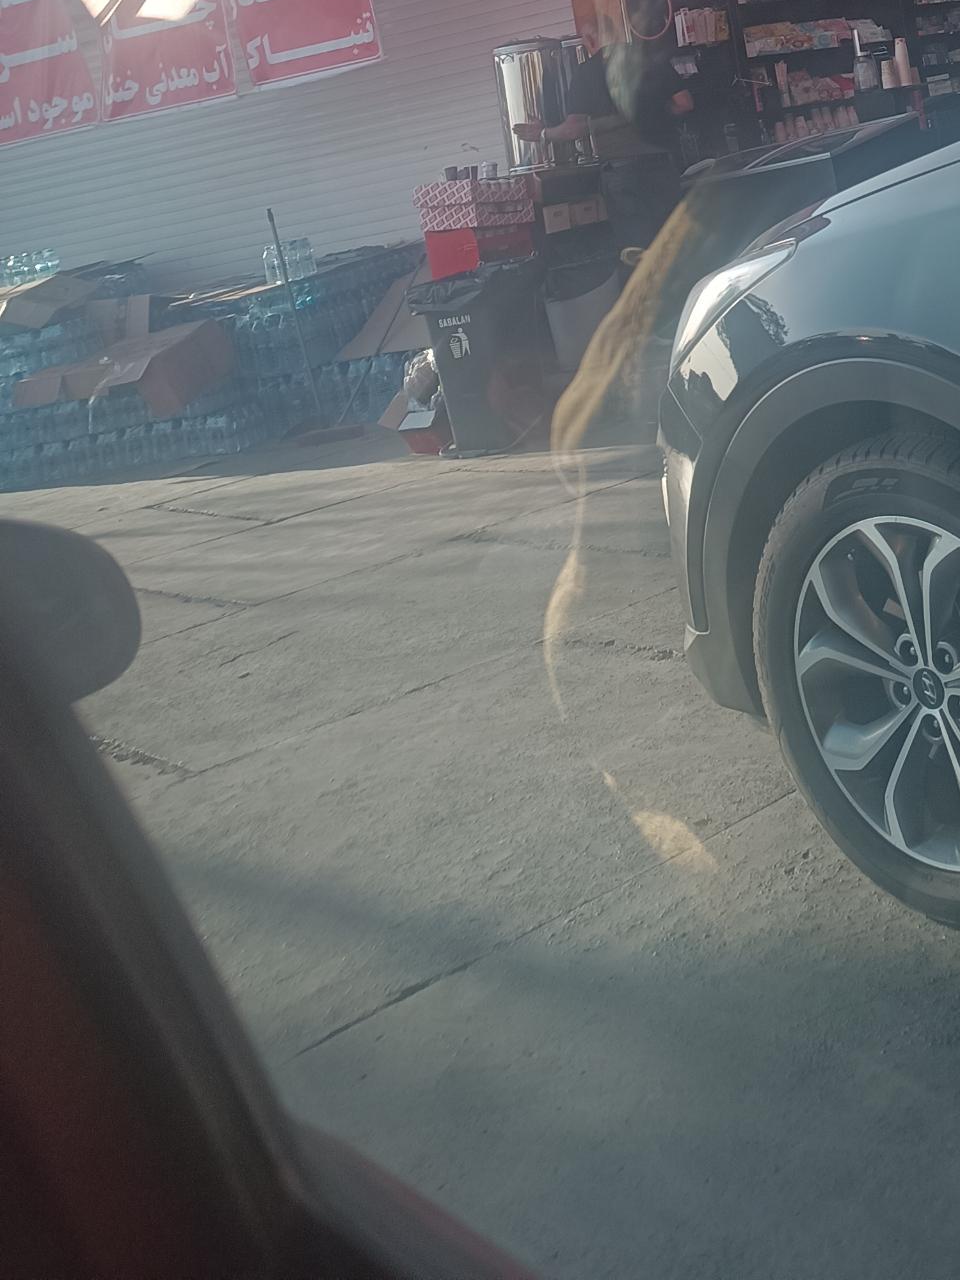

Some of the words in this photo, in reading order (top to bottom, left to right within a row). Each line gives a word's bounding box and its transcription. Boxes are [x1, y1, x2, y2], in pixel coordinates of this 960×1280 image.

[246, 13, 375, 69] تنباک
[146, 63, 199, 106] معدنی
[203, 44, 229, 90] آب
[27, 91, 94, 130] موجود
[438, 313, 471, 328] SABALAN
